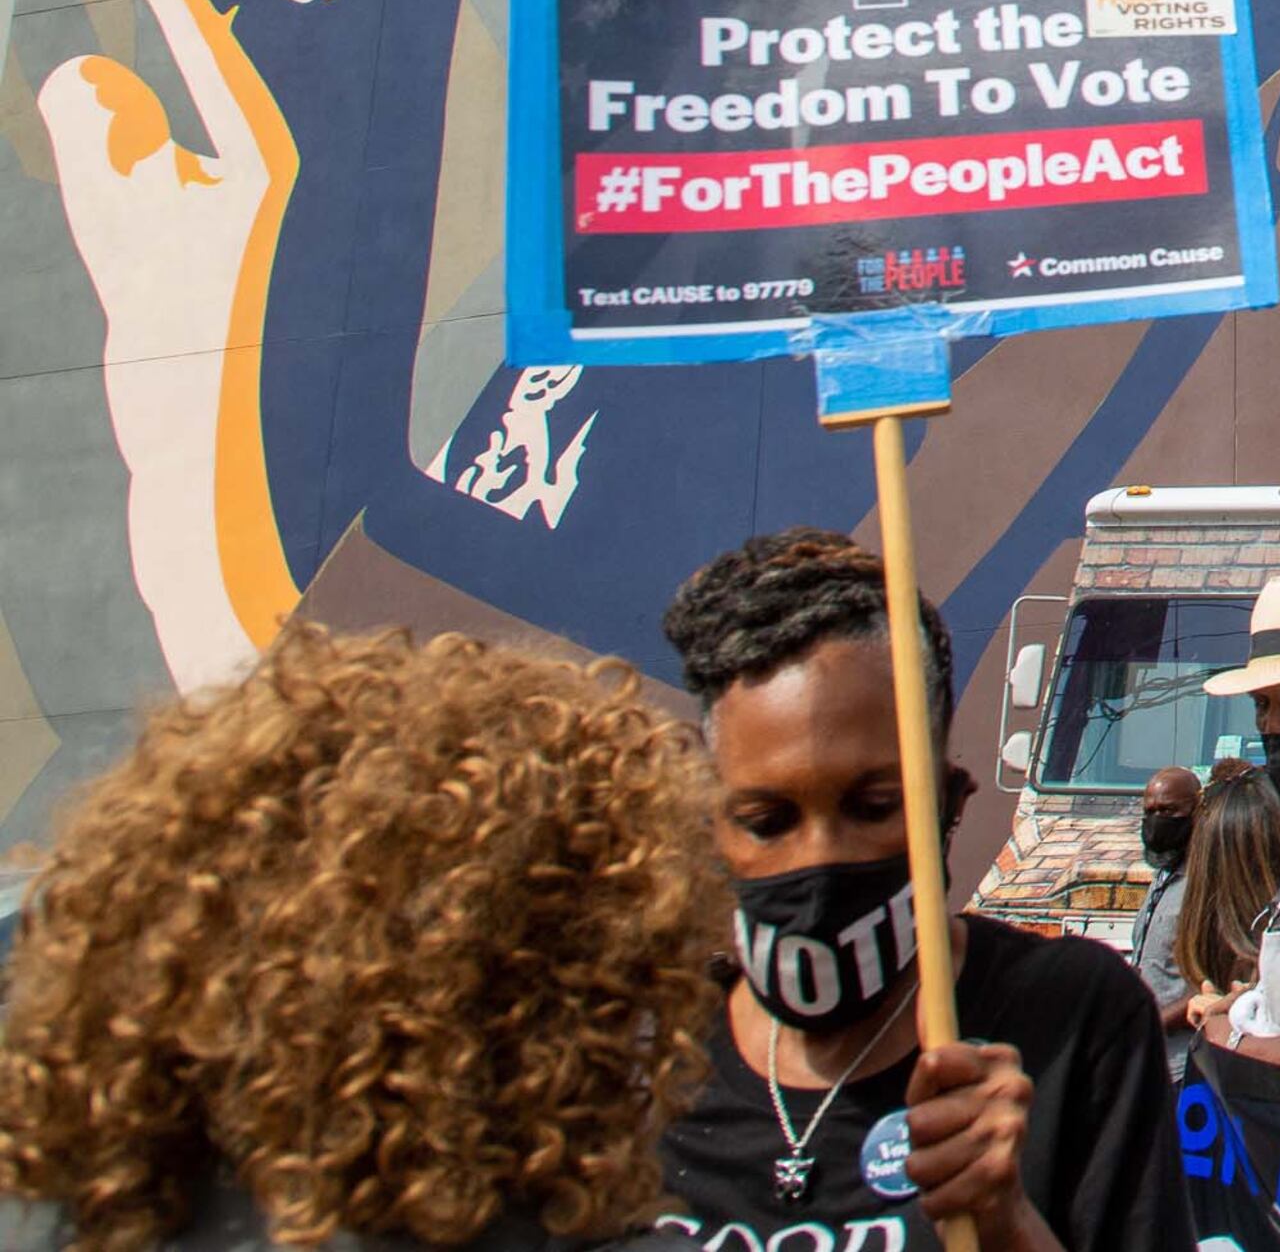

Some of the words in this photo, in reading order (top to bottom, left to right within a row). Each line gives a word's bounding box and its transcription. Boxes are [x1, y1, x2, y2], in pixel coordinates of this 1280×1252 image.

[1118, 2, 1208, 15] VOTING
[1134, 16, 1225, 30] RIGHTS
[703, 10, 960, 66] Protect
[974, 4, 1083, 51] the
[590, 76, 910, 131] Freedom
[925, 68, 1015, 116] To
[1028, 59, 1190, 108] Vote
[598, 136, 1183, 211] #ForThePeopleAct
[858, 258, 885, 276] FOR
[859, 275, 886, 293] THE
[885, 257, 965, 291] PEOPLE
[1039, 252, 1146, 277] Common
[1149, 246, 1224, 267] Cause
[579, 288, 630, 306] Text
[633, 286, 713, 305] CAUSE
[716, 284, 741, 302] to
[743, 279, 814, 300] 97779
